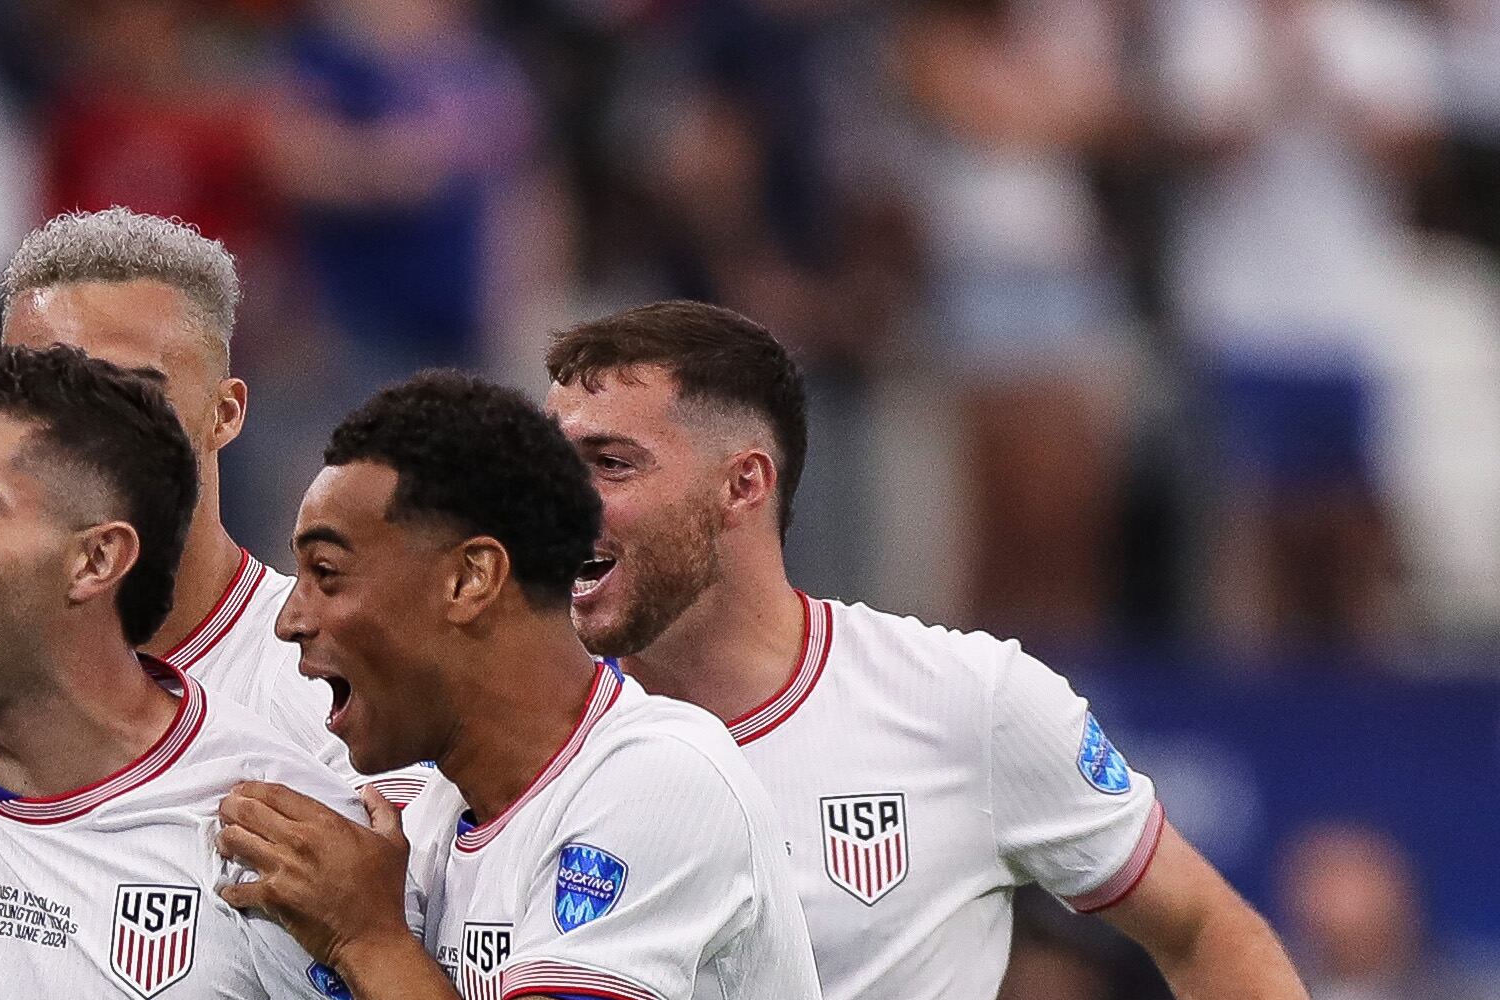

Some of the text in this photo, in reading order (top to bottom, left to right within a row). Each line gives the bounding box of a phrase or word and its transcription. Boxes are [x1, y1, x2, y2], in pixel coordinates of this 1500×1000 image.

[827, 800, 899, 841] USA
[559, 866, 614, 892] ROCKING
[121, 891, 193, 933] USA
[15, 923, 41, 943] JUNE
[41, 929, 67, 949] 2024
[466, 930, 511, 973] USA
